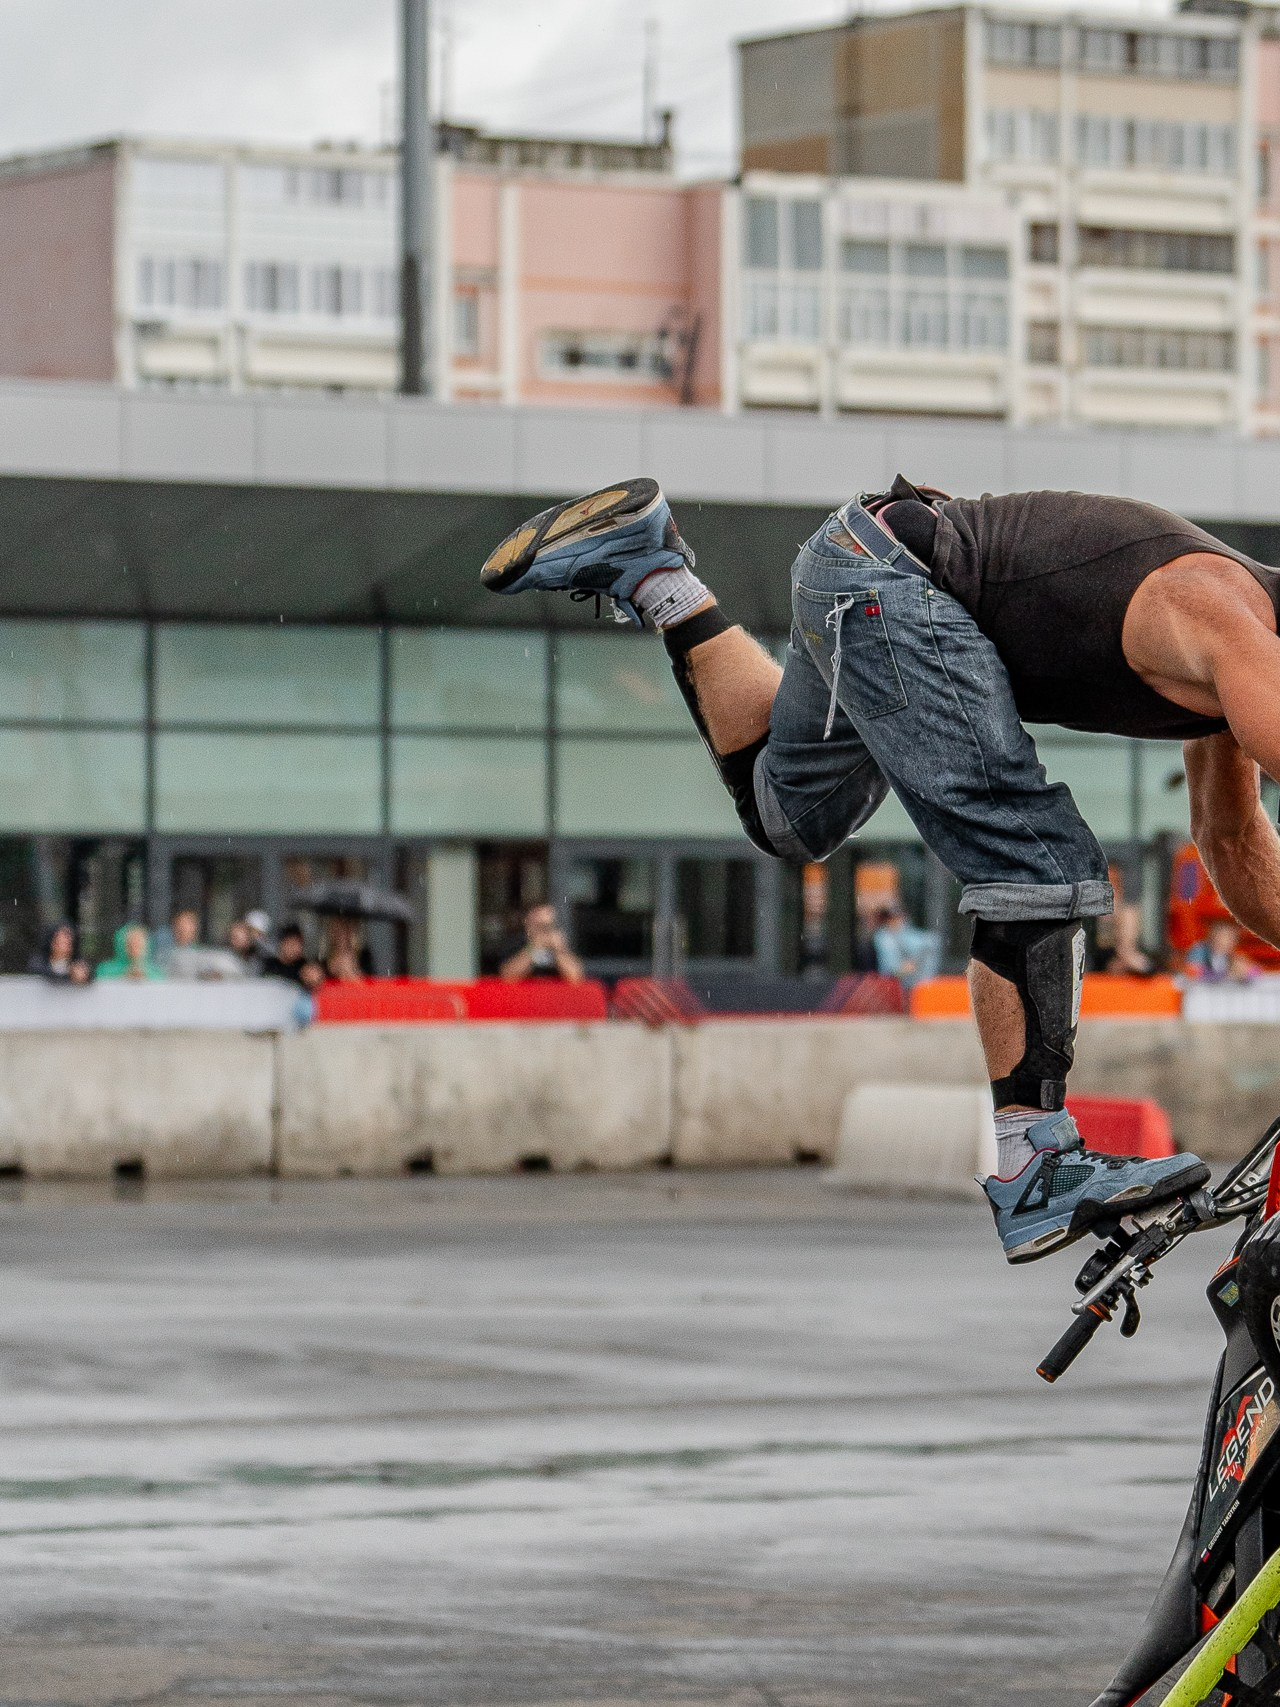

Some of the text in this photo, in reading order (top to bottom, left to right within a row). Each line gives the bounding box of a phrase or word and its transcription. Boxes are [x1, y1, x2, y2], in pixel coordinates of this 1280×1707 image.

[1207, 1377, 1275, 1502] LEGEND
[1221, 1415, 1267, 1492] STUNT TEAM
